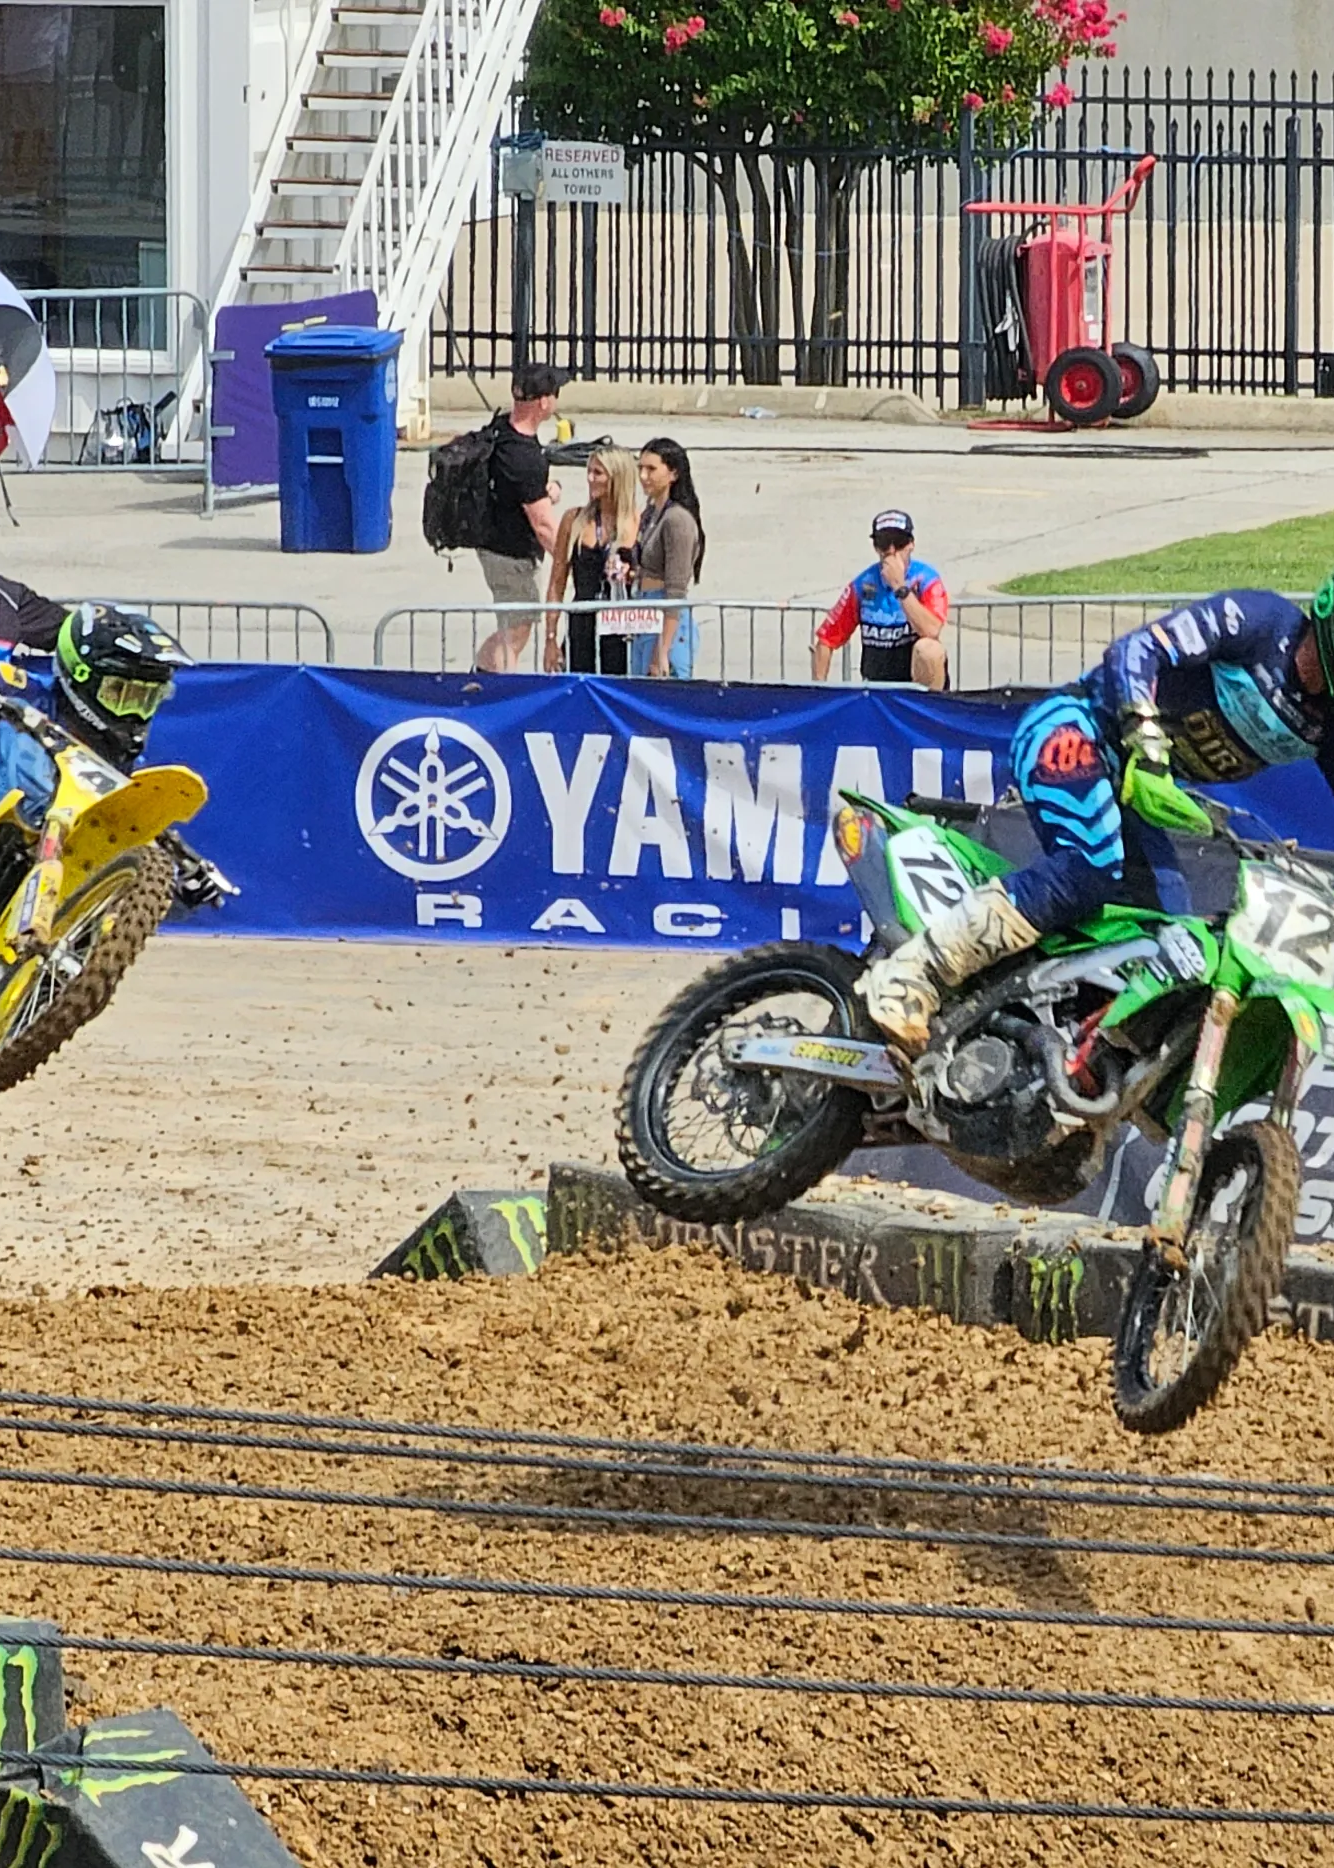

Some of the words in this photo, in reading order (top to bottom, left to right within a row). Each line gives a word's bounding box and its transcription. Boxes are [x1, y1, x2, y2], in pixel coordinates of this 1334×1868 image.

[544, 147, 620, 162] RESERVED
[551, 168, 569, 178] ALL
[572, 168, 614, 179] OTHERS
[564, 184, 602, 195] TOWED
[601, 608, 660, 622] NATIONAL
[899, 851, 966, 916] 12
